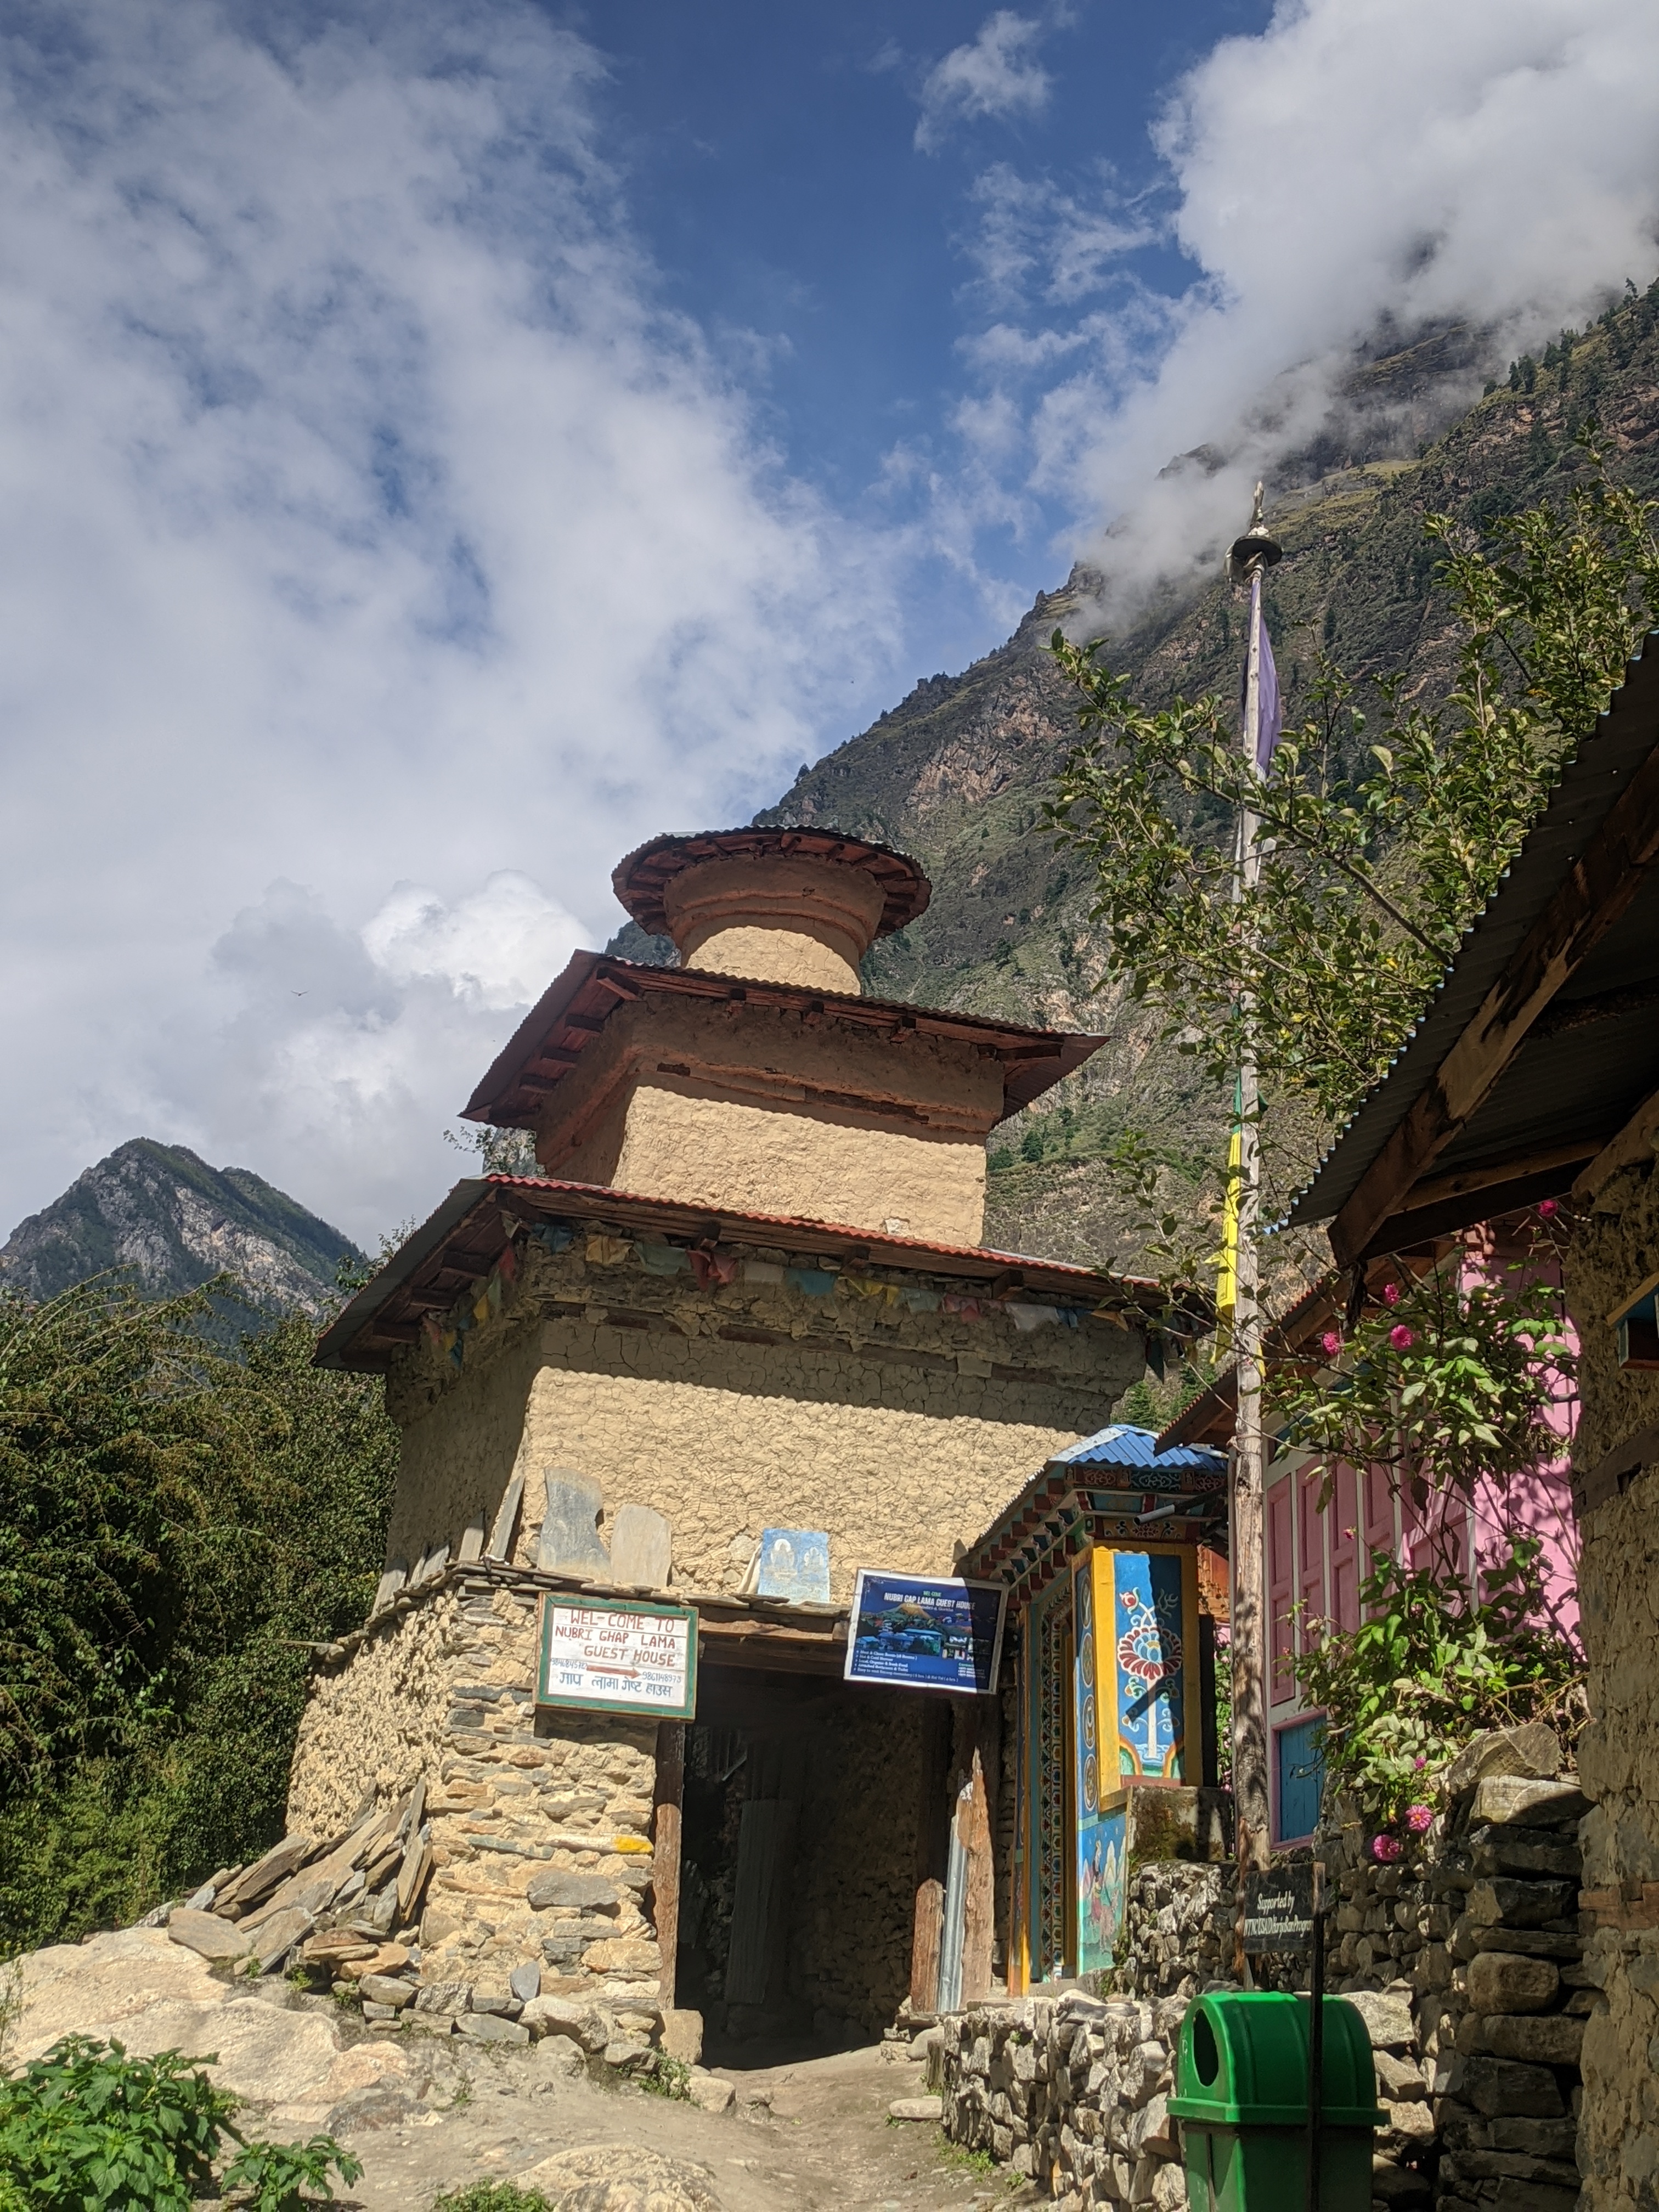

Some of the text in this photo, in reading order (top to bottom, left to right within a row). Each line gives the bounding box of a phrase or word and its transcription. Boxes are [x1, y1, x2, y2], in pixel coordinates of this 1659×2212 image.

[884, 1592, 975, 1610] NUBRI GAP LAMA GUEST HOUSE
[571, 1609, 675, 1633] WEL-COME TO
[555, 1626, 675, 1649] NUBRI GHAP LAMA
[584, 1645, 675, 1667] GUEST HOUSE
[1257, 1890, 1295, 1915] Supported by
